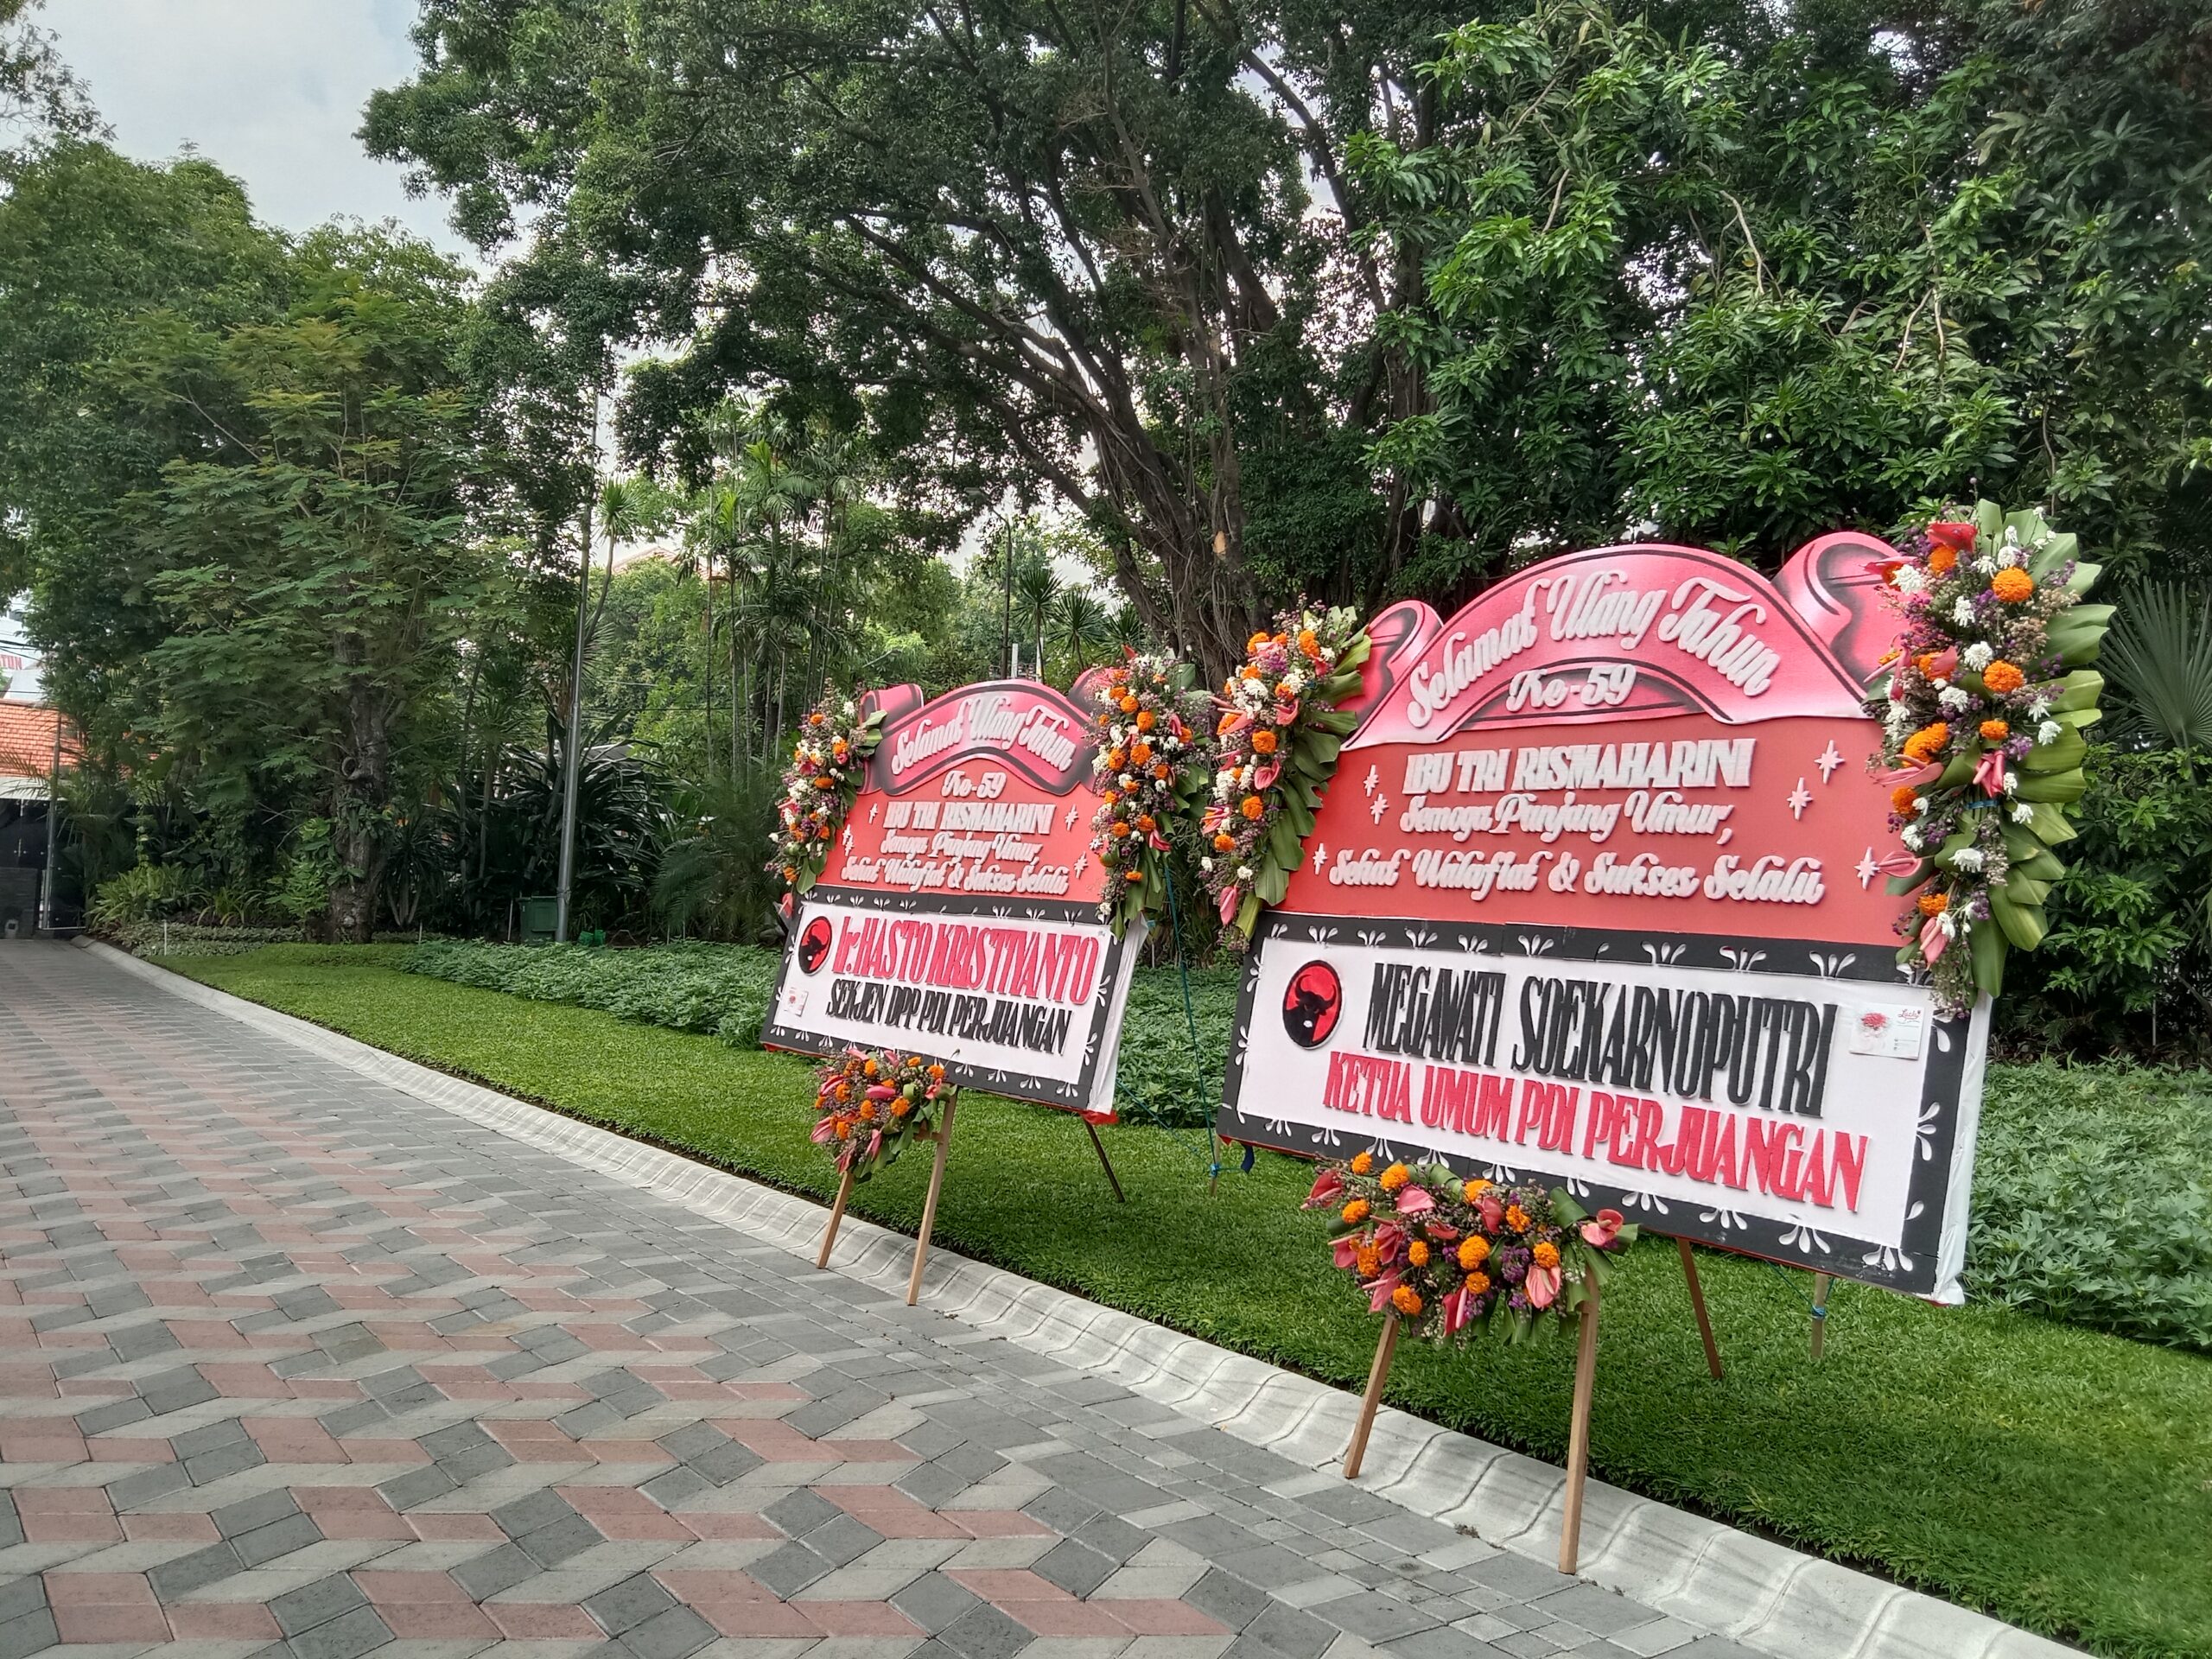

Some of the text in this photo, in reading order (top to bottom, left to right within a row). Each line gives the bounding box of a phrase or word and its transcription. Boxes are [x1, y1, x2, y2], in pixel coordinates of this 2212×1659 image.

[1406, 569, 1781, 728] Selamat Ulang Tahun
[1505, 664, 1637, 712] Ke-59
[891, 696, 1077, 775] Selamat Ulang Tahun
[941, 770, 1007, 799] Ke-59
[1402, 737, 1756, 794] IBU TRI RISMAHARINI
[883, 801, 1056, 835] IBU TRI RISMAHARINI
[1399, 789, 1734, 844] Semoga Panjang Umur,
[880, 829, 1043, 865] Semoga Panjang Umur,
[841, 856, 886, 882] Sehat
[947, 862, 964, 888] &
[963, 864, 1017, 893] Sukses
[1016, 865, 1070, 895] Selalu
[1329, 849, 1826, 905] Sehat Walafiat & Sukses Selalu
[853, 917, 933, 984] HASTO
[925, 924, 1100, 1005] KRISTIYANTO
[825, 979, 1073, 1055] SEKJEN DPP PDI PERJUANGAN
[1362, 962, 1840, 1117] MEGAWATI SOEKARNOPUTRI
[1321, 1051, 1870, 1213] KETUA UMUM PDI PERJUANGAN
